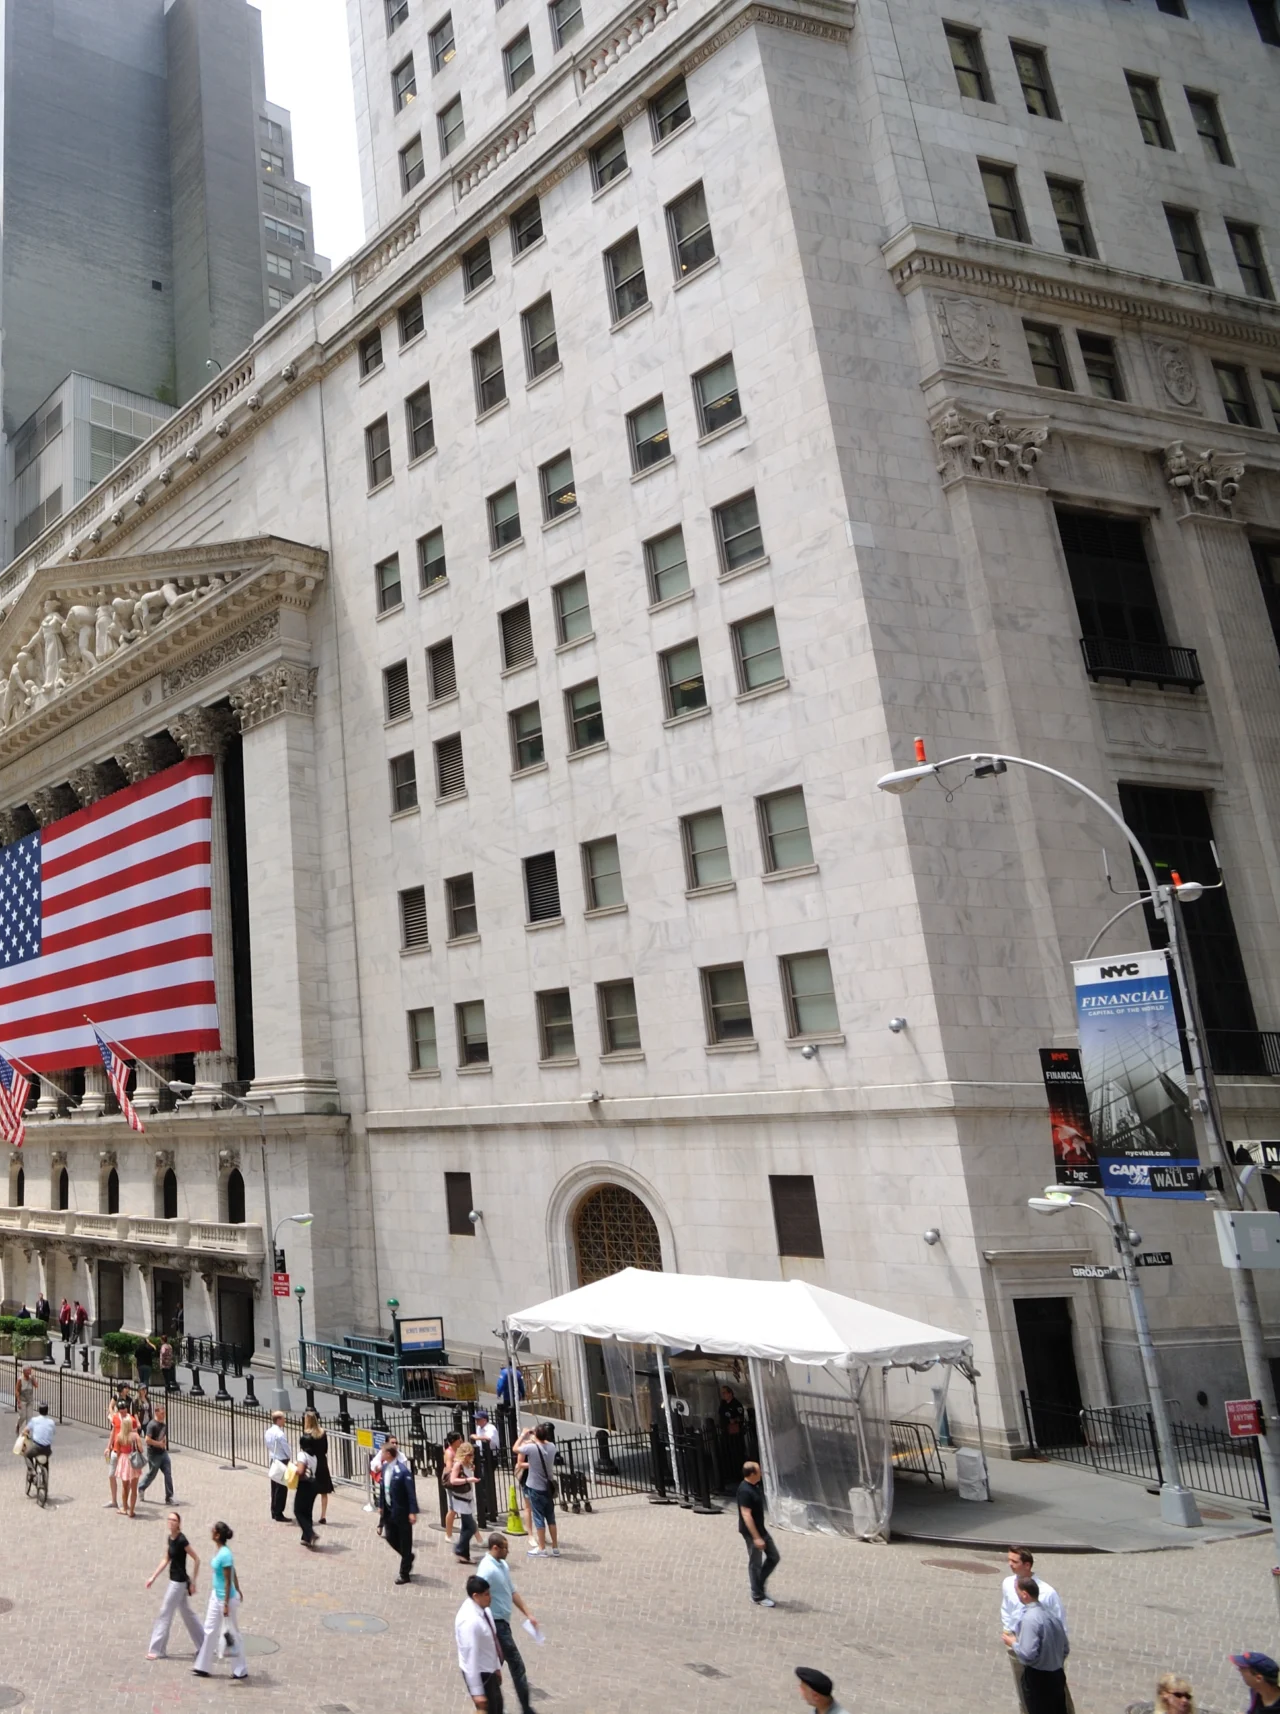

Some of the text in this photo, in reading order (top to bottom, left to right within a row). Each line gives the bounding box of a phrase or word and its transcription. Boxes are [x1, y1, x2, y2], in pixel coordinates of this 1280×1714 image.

[1100, 963, 1139, 979] NYC
[1081, 989, 1169, 1008] FINANCIAL
[1088, 1009, 1114, 1017] CAPITAL
[1045, 1071, 1083, 1080] FINANCIAL
[1125, 1149, 1171, 1157] nycvisit.com
[1073, 1169, 1089, 1181] bgc
[1153, 1172, 1195, 1187] WALL ST
[1146, 1254, 1167, 1264] WALL
[1072, 1267, 1105, 1278] BROAD
[1228, 1404, 1235, 1412] NO
